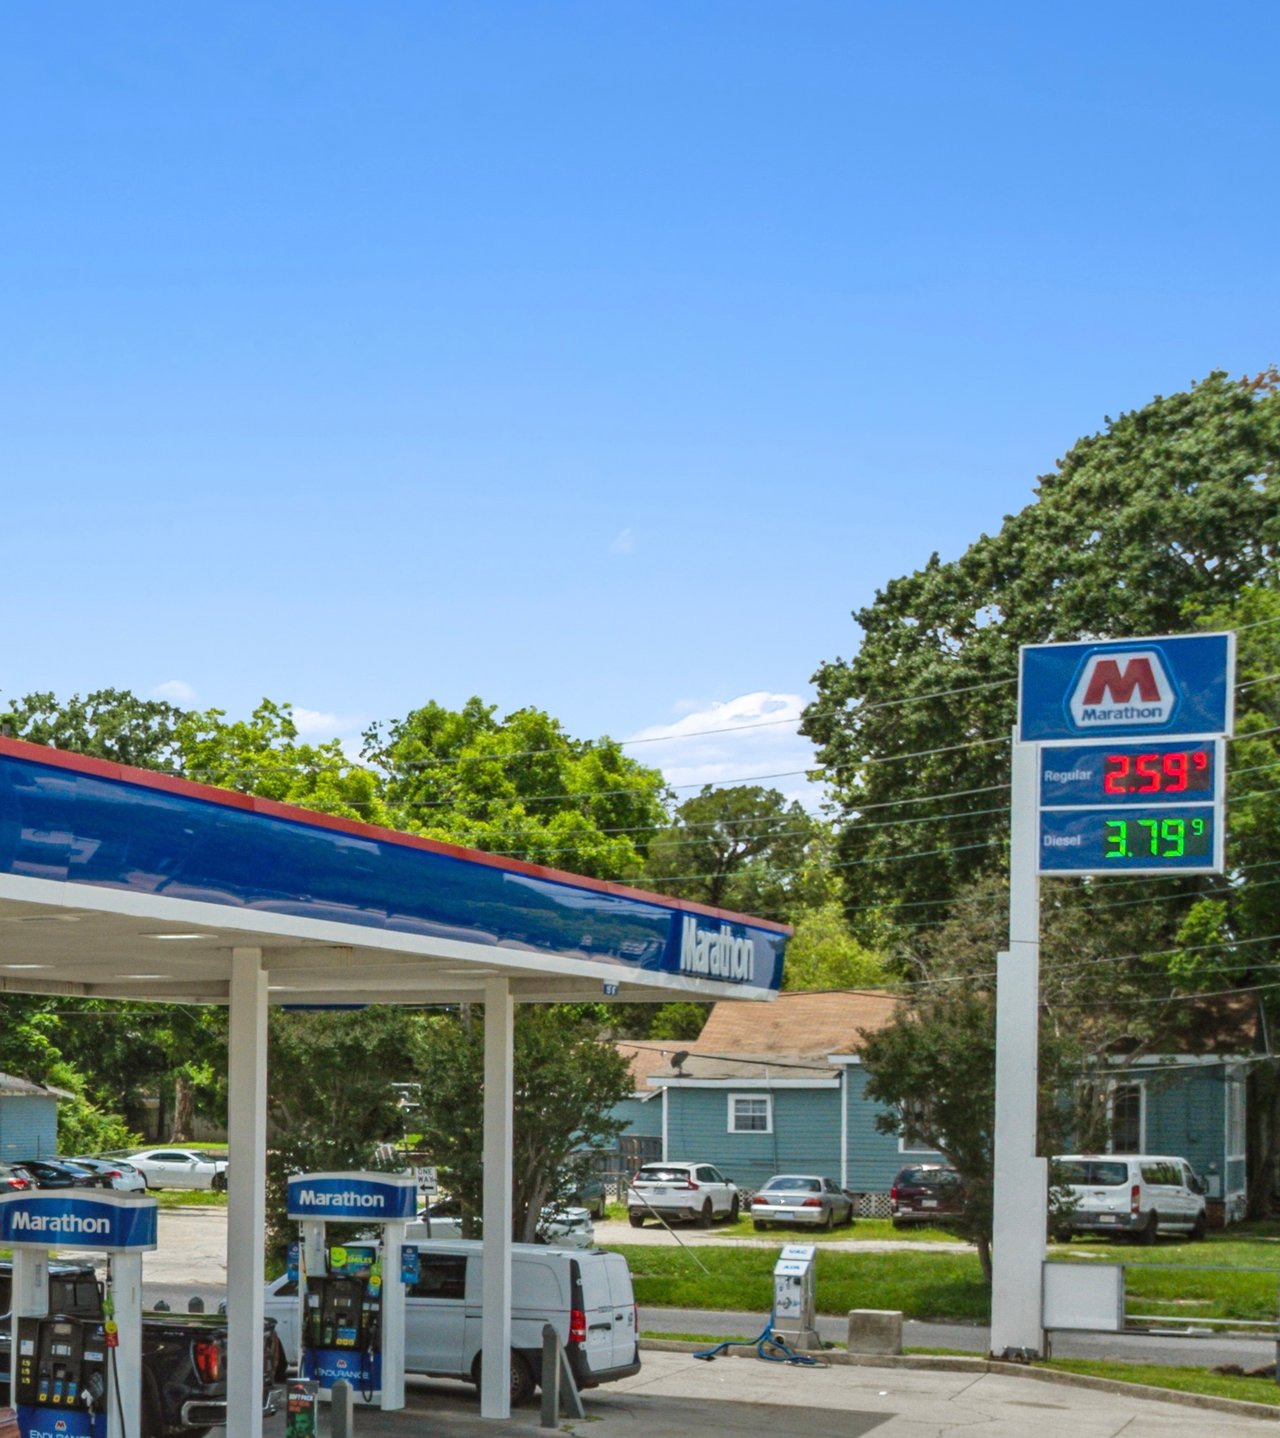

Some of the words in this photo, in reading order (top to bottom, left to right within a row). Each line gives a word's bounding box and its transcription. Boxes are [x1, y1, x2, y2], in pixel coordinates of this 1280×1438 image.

[1083, 658, 1161, 705] M
[1081, 706, 1163, 721] Marathon
[1044, 770, 1093, 783] Regular
[1043, 835, 1081, 846] Diesel
[680, 915, 755, 982] Marathon
[418, 1175, 436, 1183] WAY
[299, 1190, 385, 1208] Marathon
[11, 1211, 110, 1234] Marathon
